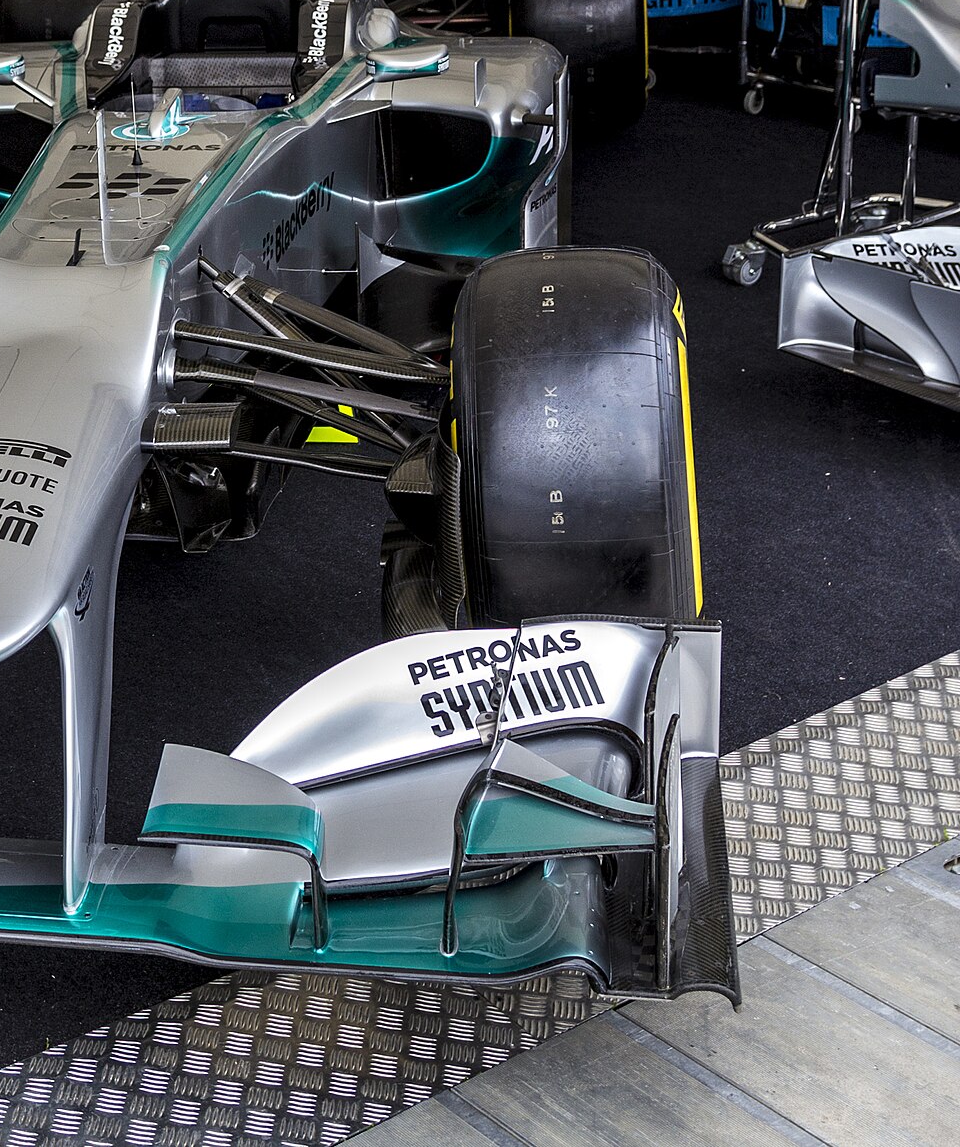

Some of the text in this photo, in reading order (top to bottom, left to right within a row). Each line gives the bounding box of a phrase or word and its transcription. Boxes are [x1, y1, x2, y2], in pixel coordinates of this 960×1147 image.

[69, 144, 221, 152] PETRONAS
[275, 171, 335, 264] BlackBerry
[544, 386, 559, 429] 97 K
[407, 629, 581, 686] PETRONAS
